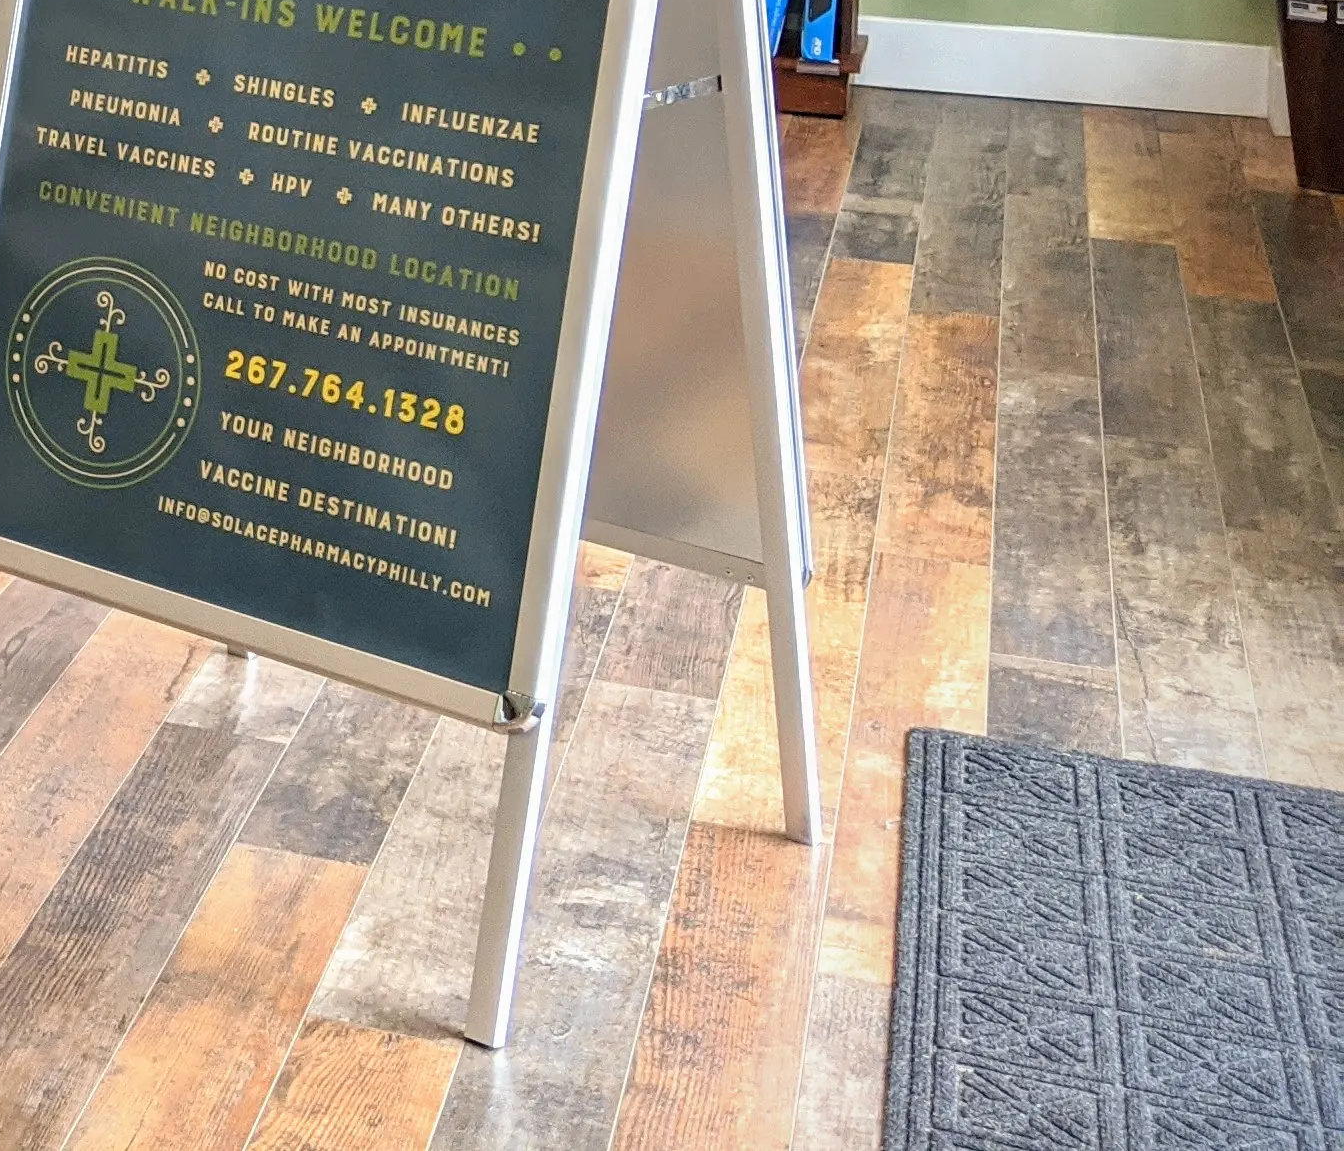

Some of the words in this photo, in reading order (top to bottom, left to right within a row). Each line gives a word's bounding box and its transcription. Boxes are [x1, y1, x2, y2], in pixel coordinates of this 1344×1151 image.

[315, 3, 488, 59] WELCOME
[65, 45, 169, 79] HEPATITIS
[233, 74, 335, 108] SHINGLES
[401, 102, 541, 143] INFLUENZAE
[69, 90, 181, 127] PNEUMONIA
[248, 121, 338, 155] ROUTINE
[348, 141, 515, 188] VACCINATIONS
[36, 126, 107, 157] TRAVEL
[116, 144, 216, 178] VACCINES
[271, 172, 312, 198] HPV
[372, 191, 432, 223] MANY
[441, 206, 541, 243] OTHERS!
[38, 180, 180, 227] CONVENIENT
[189, 211, 377, 270] NEIGHBORHOOD
[388, 253, 520, 301] LOCATION
[202, 292, 244, 316] CALL
[252, 302, 276, 323] TO
[282, 309, 330, 336] MAKE
[336, 322, 362, 343] AN
[368, 330, 510, 378] APPOINTMENT!
[204, 260, 228, 280] NO
[233, 266, 280, 291] COST
[287, 279, 335, 305] WITH
[341, 291, 392, 318] MOST
[398, 303, 521, 347] INSURANCES
[224, 350, 466, 436] 267.764.1328
[219, 411, 273, 444] YOUR
[283, 427, 454, 491] NEIGHBORHOOD
[199, 460, 289, 503] VACCINE
[298, 487, 457, 550] DESTINATION!
[158, 495, 492, 608] INFO@SOLACEPHARMACYPHILLY.COM
